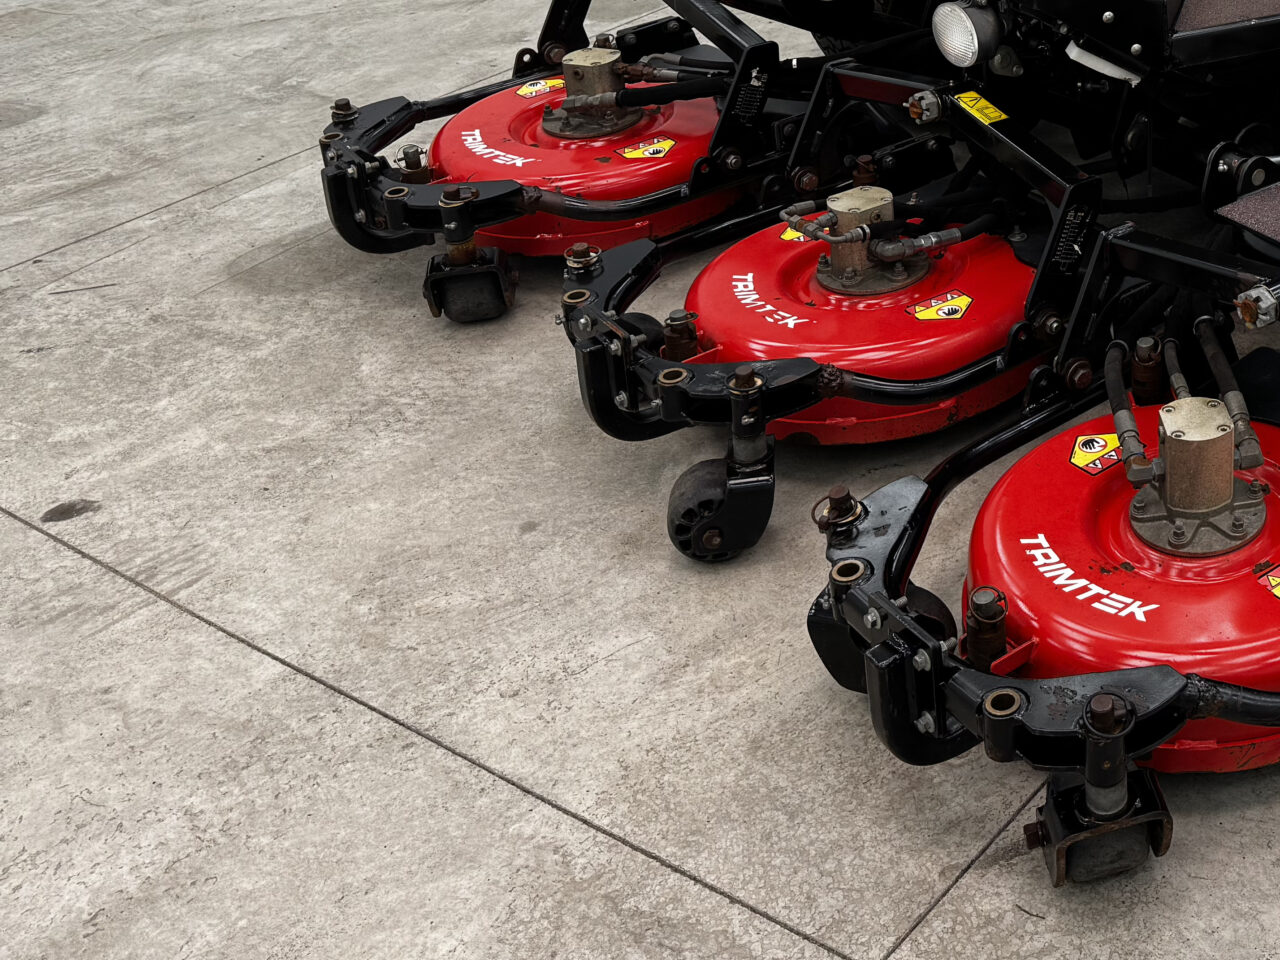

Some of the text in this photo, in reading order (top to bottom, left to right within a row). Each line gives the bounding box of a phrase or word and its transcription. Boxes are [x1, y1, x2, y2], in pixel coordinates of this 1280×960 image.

[461, 129, 536, 168] TRIMTEK
[731, 272, 810, 329] TRIMTEK
[1019, 533, 1160, 622] TRIMTEK
